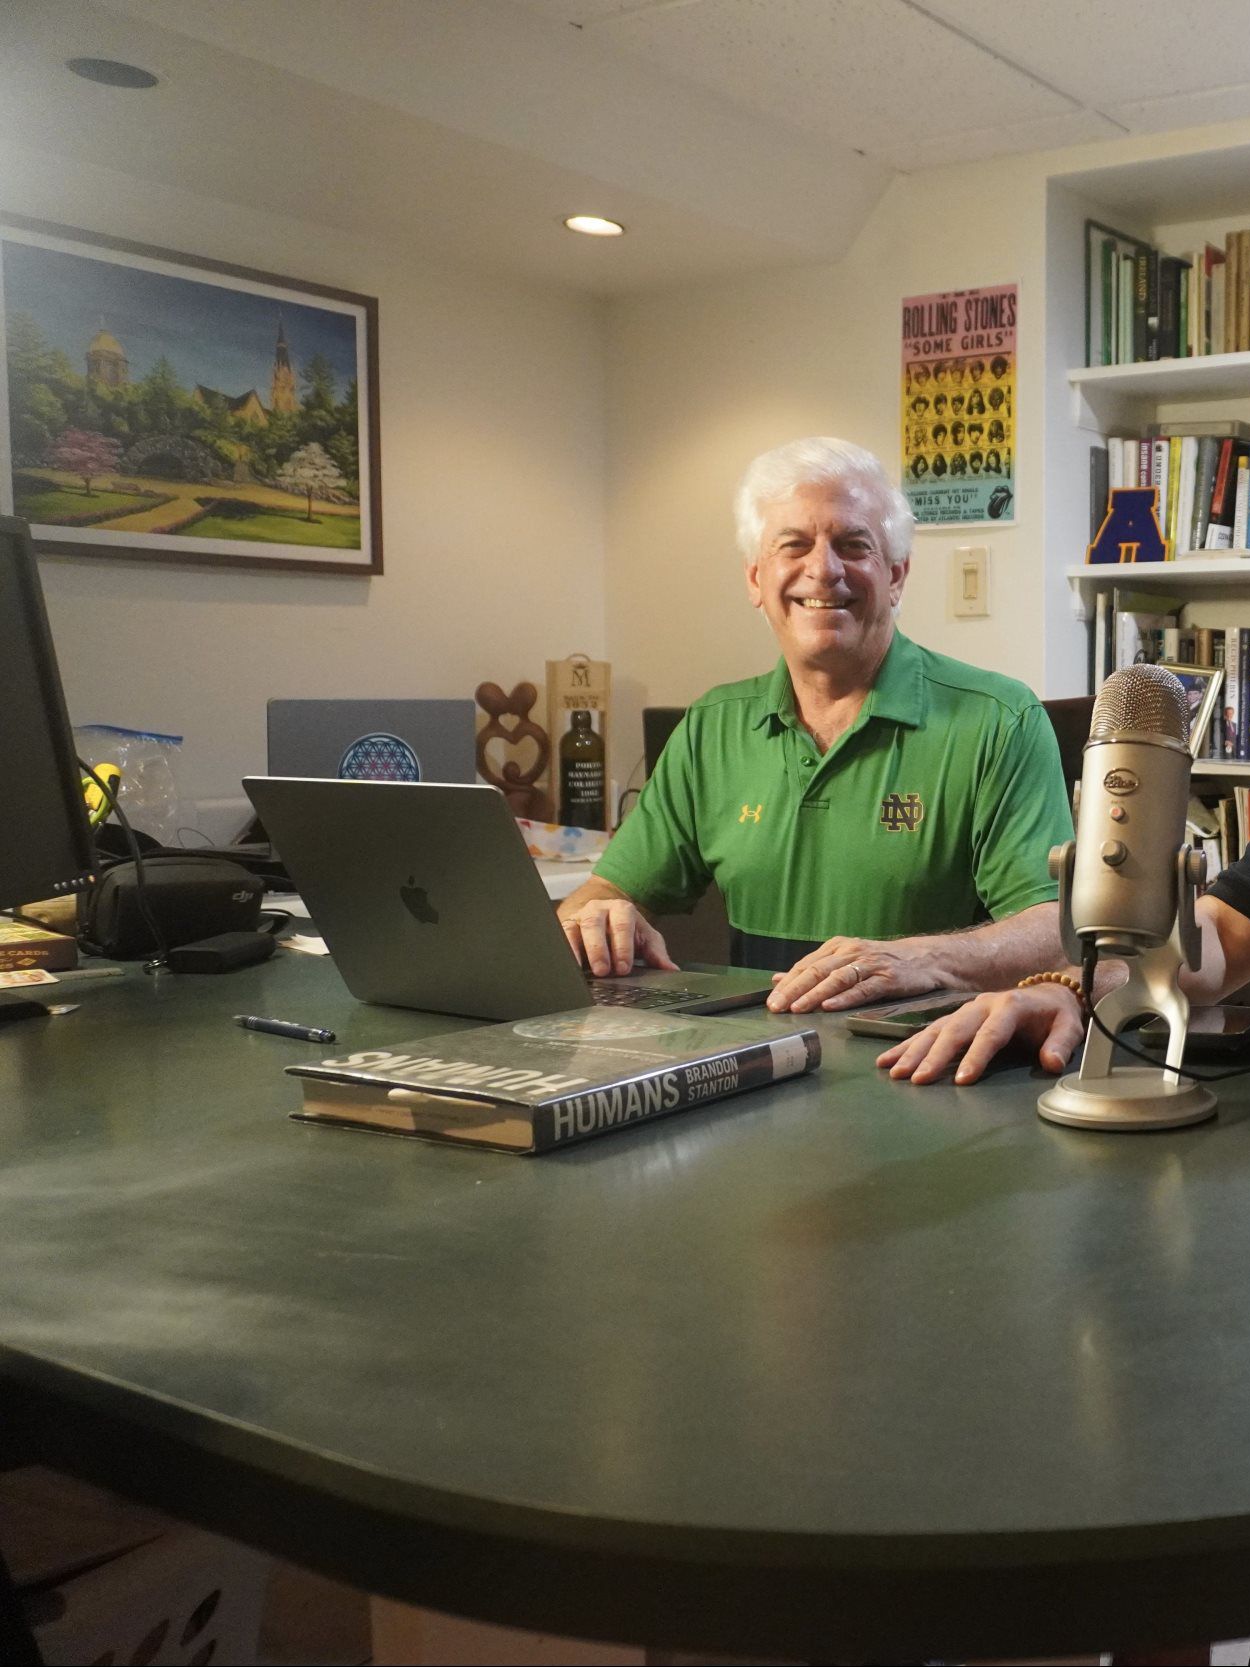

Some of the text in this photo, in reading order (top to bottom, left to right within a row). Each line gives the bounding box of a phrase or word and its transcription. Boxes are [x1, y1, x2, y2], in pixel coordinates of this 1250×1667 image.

[1135, 255, 1149, 301] IRELAND
[902, 292, 1017, 339] ROLLING STONES
[904, 330, 1014, 357] "SOME GIRLS"
[1140, 442, 1150, 470] insane
[1228, 664, 1237, 699] PHILBIN
[232, 890, 255, 903] dji
[321, 1050, 590, 1097] HUMANS
[685, 1056, 739, 1085] BRANDON
[687, 1074, 740, 1101] STANTON
[553, 1072, 681, 1142] HUMANS
